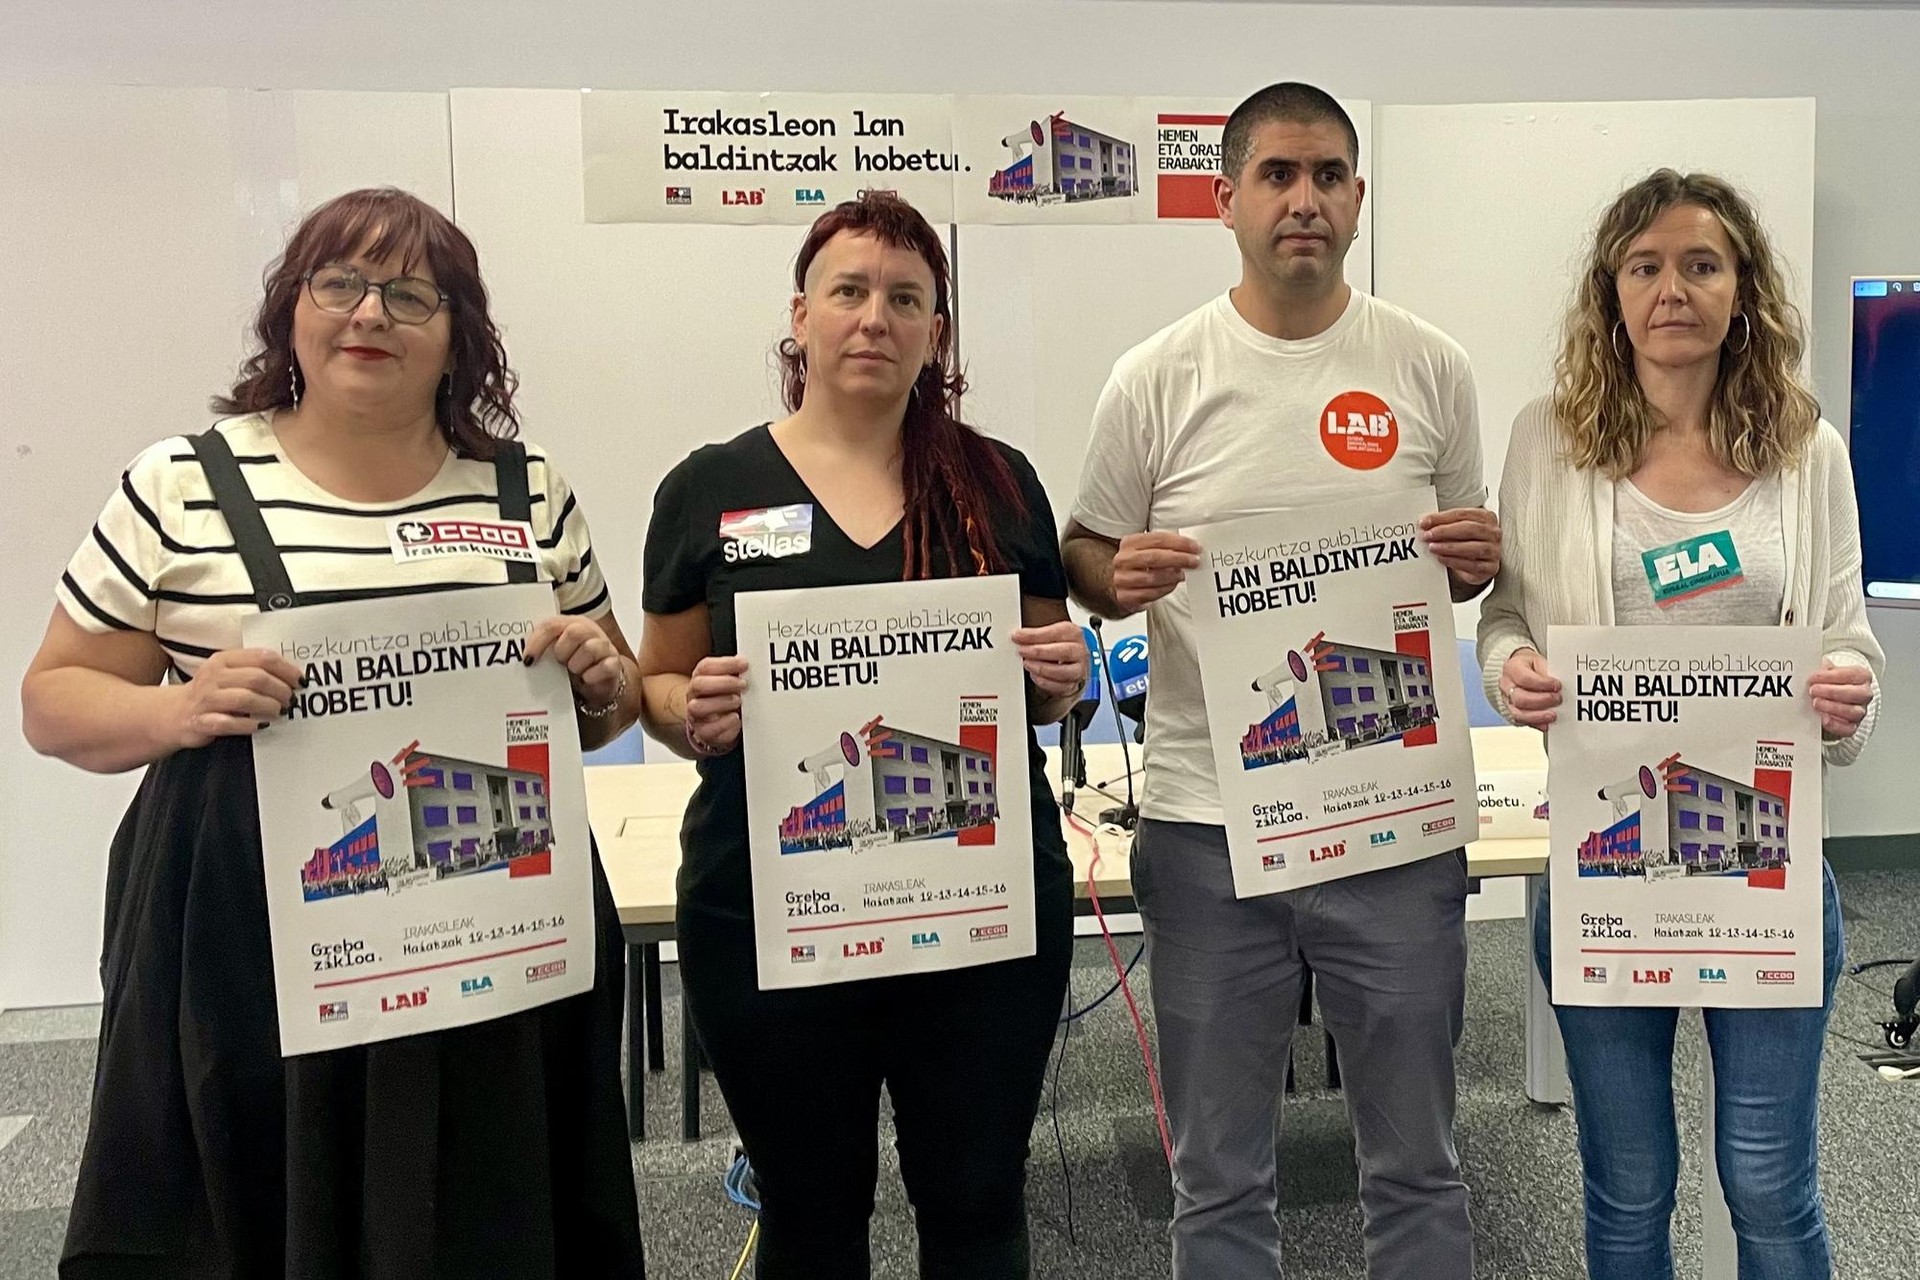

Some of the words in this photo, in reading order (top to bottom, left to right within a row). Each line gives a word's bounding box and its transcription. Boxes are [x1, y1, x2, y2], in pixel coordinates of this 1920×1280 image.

[664, 109, 836, 136] Irakasleon
[853, 111, 904, 136] lan
[1158, 129, 1198, 142] HEMEN
[664, 144, 837, 172] baldintzak
[855, 146, 971, 171] hobetu.
[1158, 144, 1182, 156] ETA
[1190, 144, 1221, 156] ORAI
[1158, 158, 1221, 170] ERABAKIT
[722, 189, 764, 206] LAB
[796, 189, 825, 201] ELA
[1327, 411, 1390, 437] LAB
[437, 525, 522, 545] CCOO
[1210, 541, 1311, 568] Hezkuntza
[1318, 523, 1415, 555] publikoan
[1214, 565, 1262, 593] LAN
[1269, 537, 1419, 584] BALDINTZAK
[1653, 542, 1728, 586] ELA
[1218, 580, 1317, 618] HOBETU!
[768, 618, 878, 639] Hezkuntza
[886, 607, 993, 635] publikoan
[281, 634, 410, 660] Hezkuntza
[420, 618, 535, 651] publikoan
[769, 639, 820, 665] LAN
[831, 626, 994, 660] BALDINTZAK
[304, 659, 343, 687] AN
[1576, 653, 1680, 672] Hezkuntza
[1689, 653, 1793, 676] publikoan
[771, 661, 878, 691] HOBETU!
[1577, 675, 1623, 696] LAN
[1635, 675, 1793, 698] BALDINTZAK
[288, 681, 413, 720] HOBETU!
[1577, 699, 1679, 723] HOBETU!
[1323, 781, 1379, 801] IRAKASLEAK
[1374, 779, 1452, 804] 12-13-14-15-16
[1477, 784, 1495, 792] an
[1252, 800, 1294, 816] Greba
[1478, 796, 1525, 808] obetu.
[1370, 831, 1397, 845] ELA
[1309, 841, 1346, 863] LAB
[863, 878, 926, 894] IRAKASLEAK
[920, 883, 1007, 902] 12-13-14-15-16
[785, 889, 830, 904] Greba
[403, 917, 475, 940] IRAKASLEAK
[1581, 913, 1623, 926] Greba
[1656, 913, 1716, 924] IRAKASLEAK
[469, 915, 565, 944] 12-13-14-15-16
[912, 932, 940, 944] ELA
[1708, 927, 1795, 939] 12-13-14-15-16
[311, 938, 364, 957] Greba
[843, 939, 883, 958] LAB
[461, 976, 493, 993] ELA
[1633, 969, 1673, 984] LAB
[1700, 969, 1728, 980] ELA
[381, 988, 428, 1012] LAB
